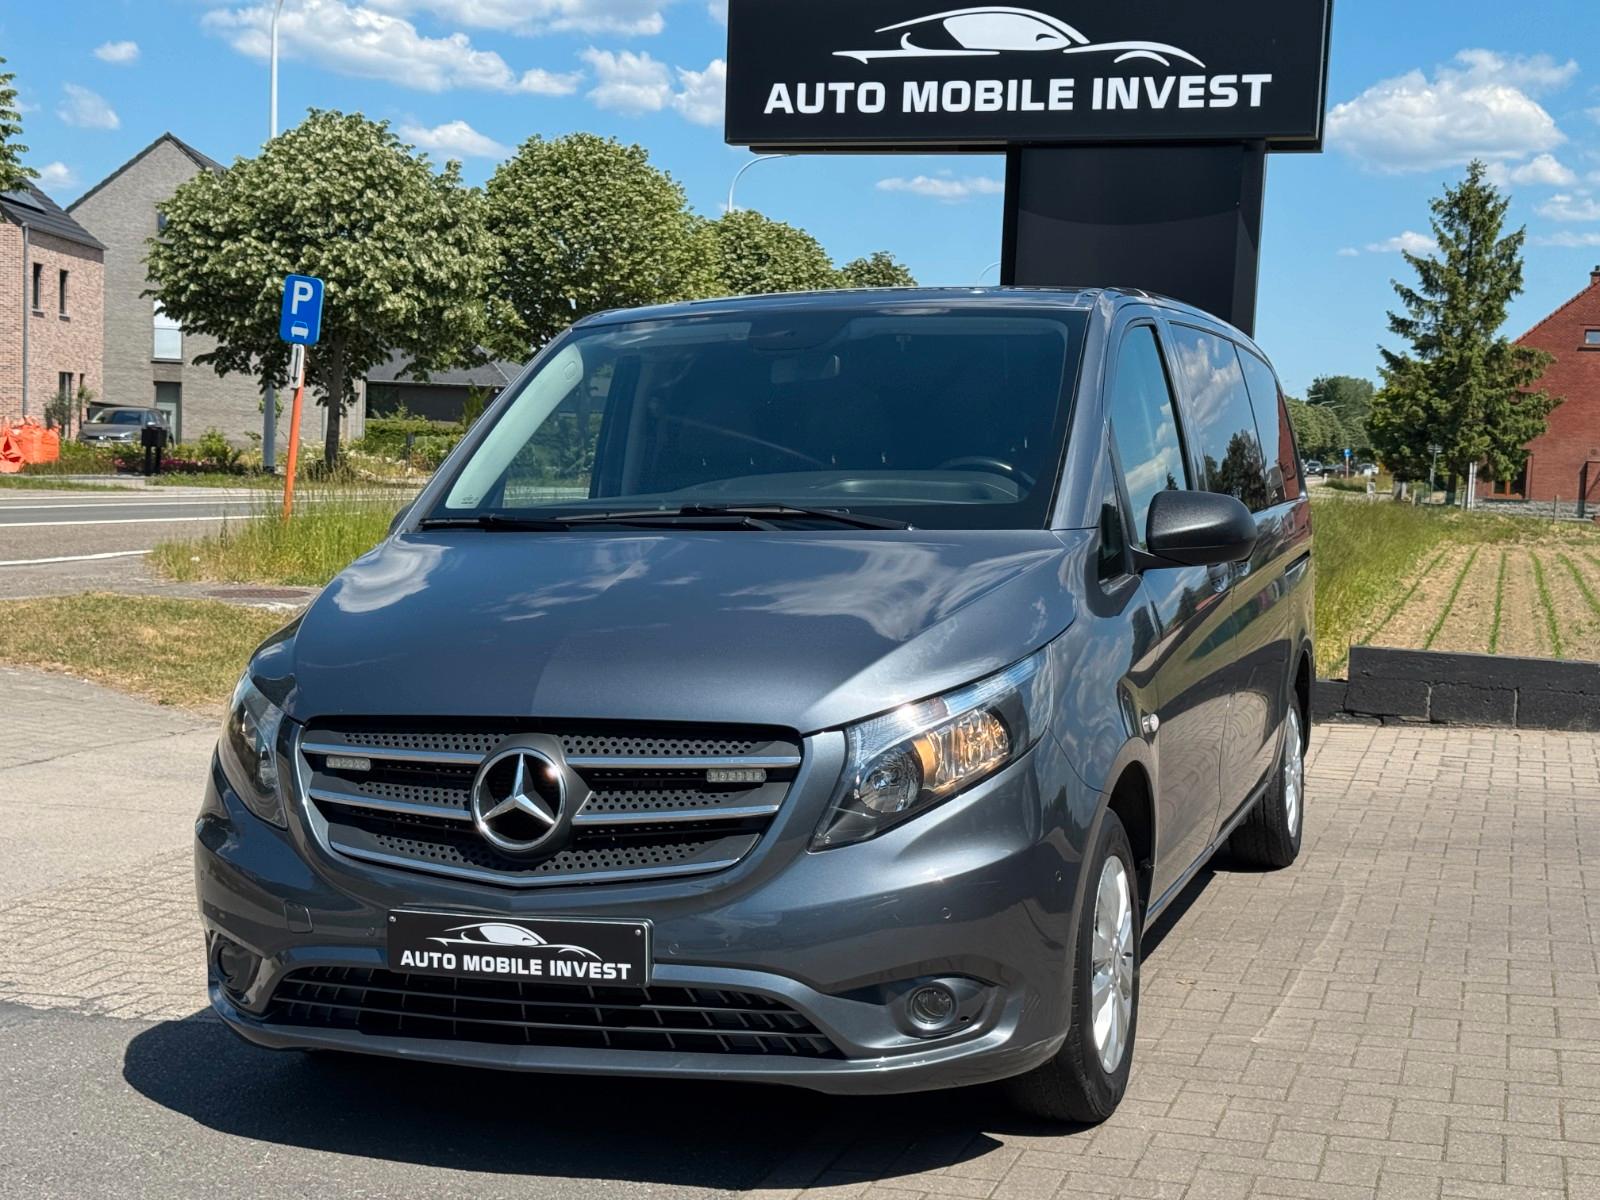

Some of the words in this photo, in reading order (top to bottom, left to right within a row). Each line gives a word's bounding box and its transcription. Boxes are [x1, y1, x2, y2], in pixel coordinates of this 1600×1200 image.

[763, 81, 886, 114] AUTO
[902, 78, 1076, 113] MOBILE
[1091, 73, 1273, 110] INVEST
[291, 280, 314, 315] P
[400, 949, 457, 970] AUTO
[463, 954, 543, 976] MOBILE
[549, 959, 632, 980] INVEST
